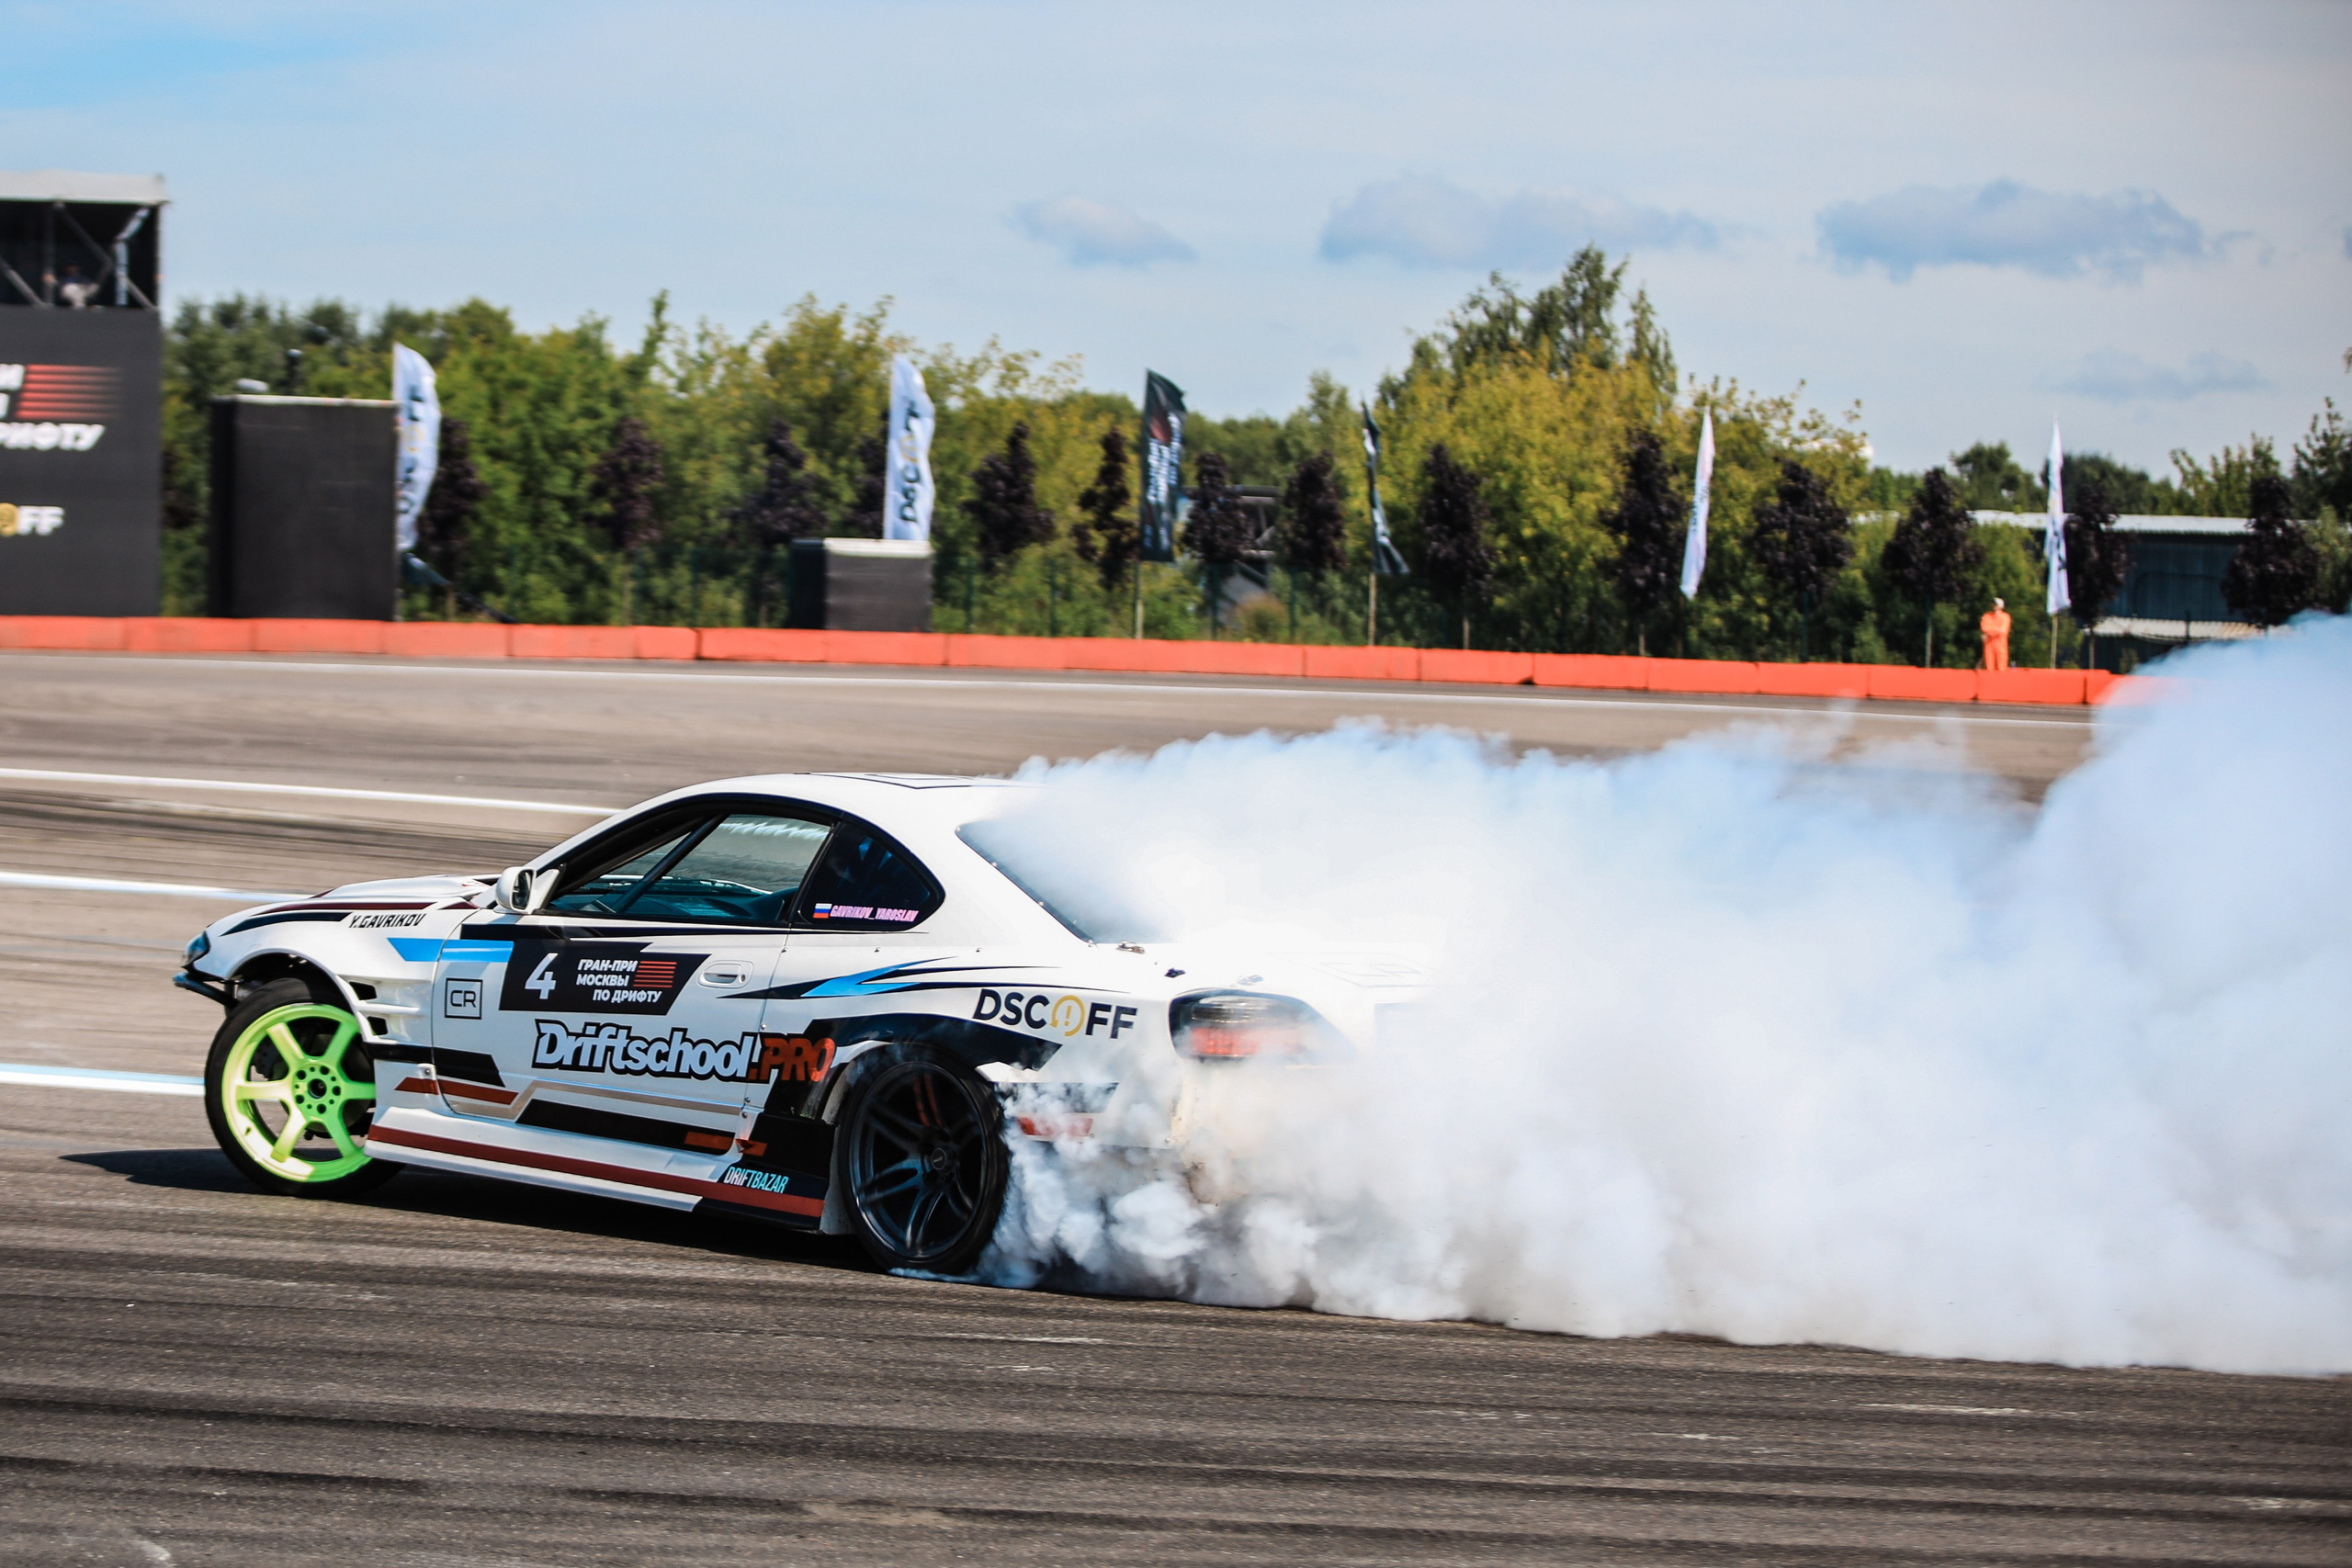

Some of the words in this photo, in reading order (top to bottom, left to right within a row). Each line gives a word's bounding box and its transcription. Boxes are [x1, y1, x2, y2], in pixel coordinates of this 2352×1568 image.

[577, 959, 638, 972] ГРАН-ПРИ
[525, 953, 559, 999] 4
[576, 974, 629, 987] МОСКВЫ
[450, 989, 476, 1008] CR
[593, 989, 610, 1001] ПО
[611, 990, 662, 1003] ДРИФТУ
[723, 1166, 790, 1194] DRIFTBAZAR
